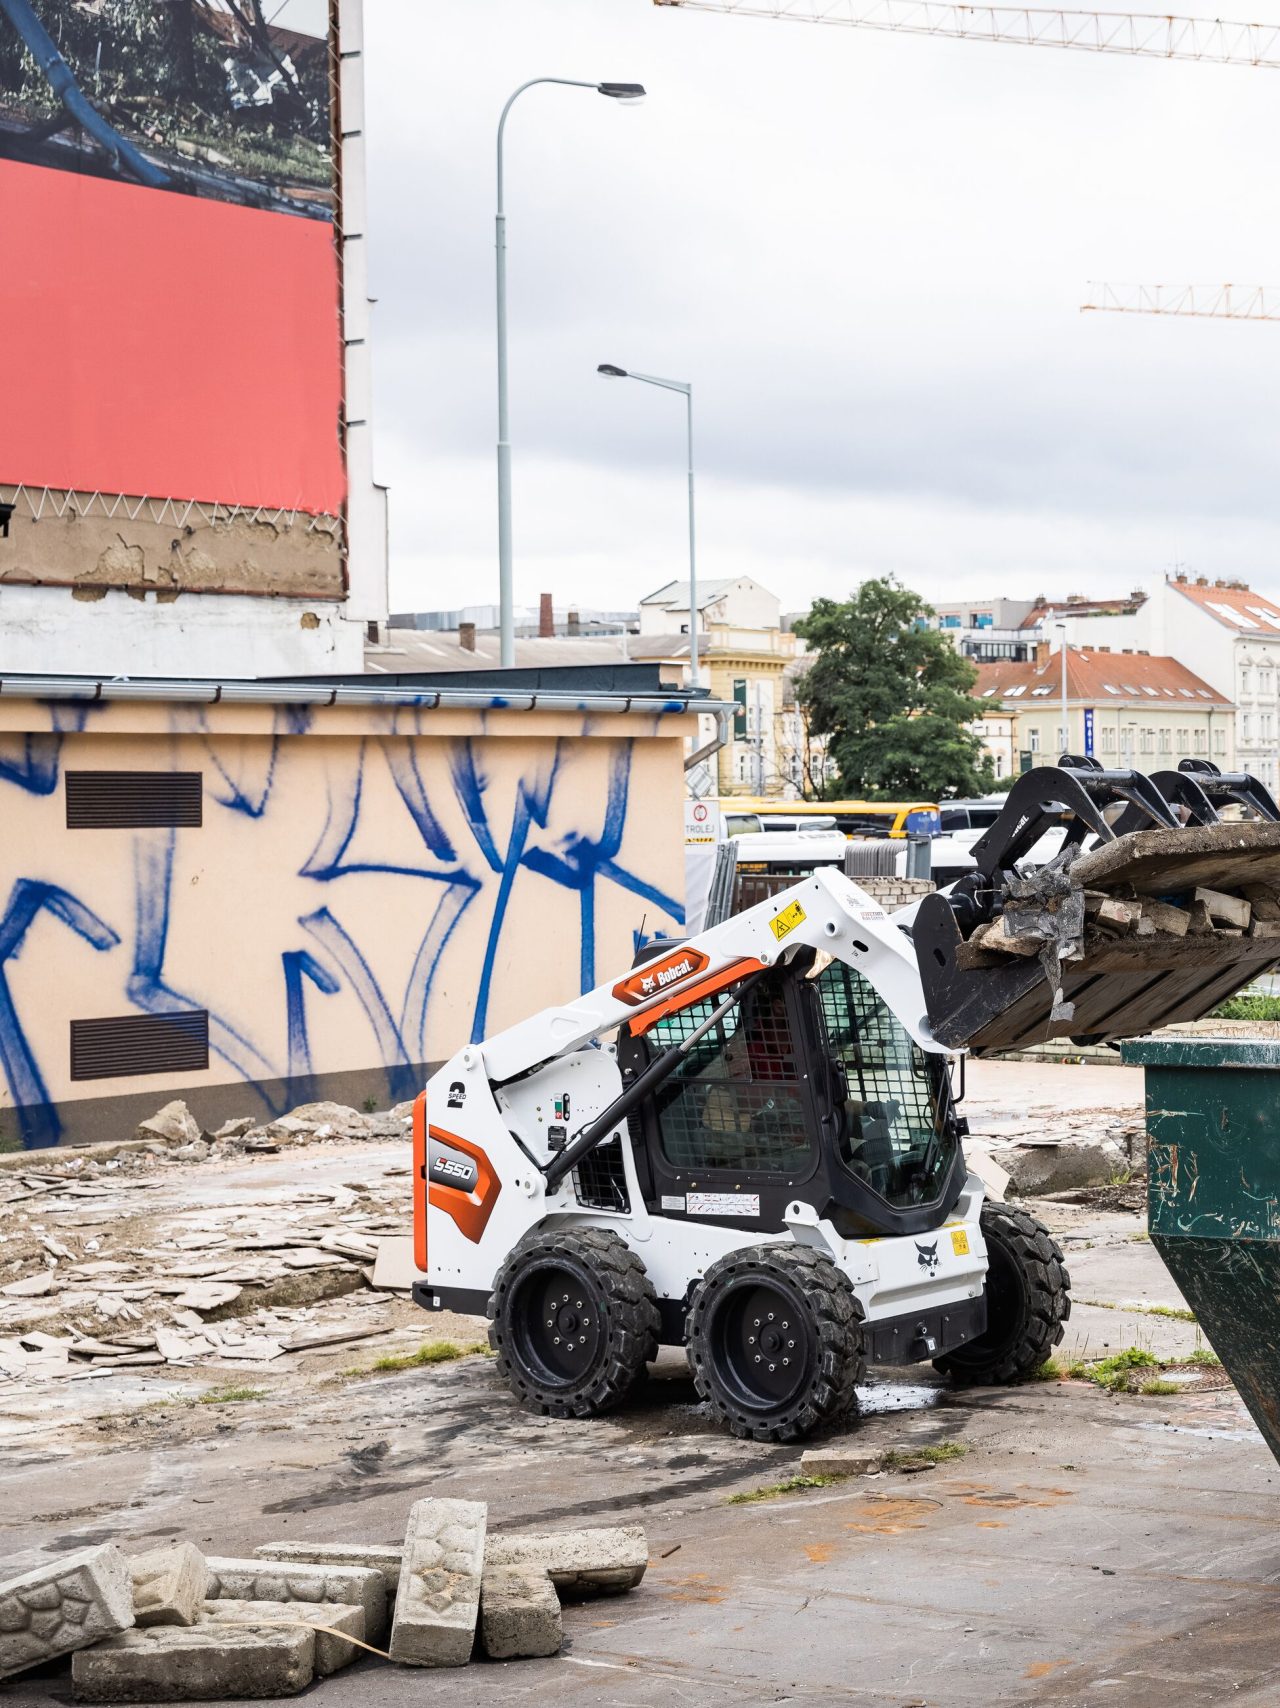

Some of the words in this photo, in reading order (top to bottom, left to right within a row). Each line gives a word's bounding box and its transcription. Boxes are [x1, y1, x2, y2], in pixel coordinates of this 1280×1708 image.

[685, 824, 715, 834] TROLEJ
[447, 1081, 466, 1109] 2
[433, 1157, 474, 1180] S550
